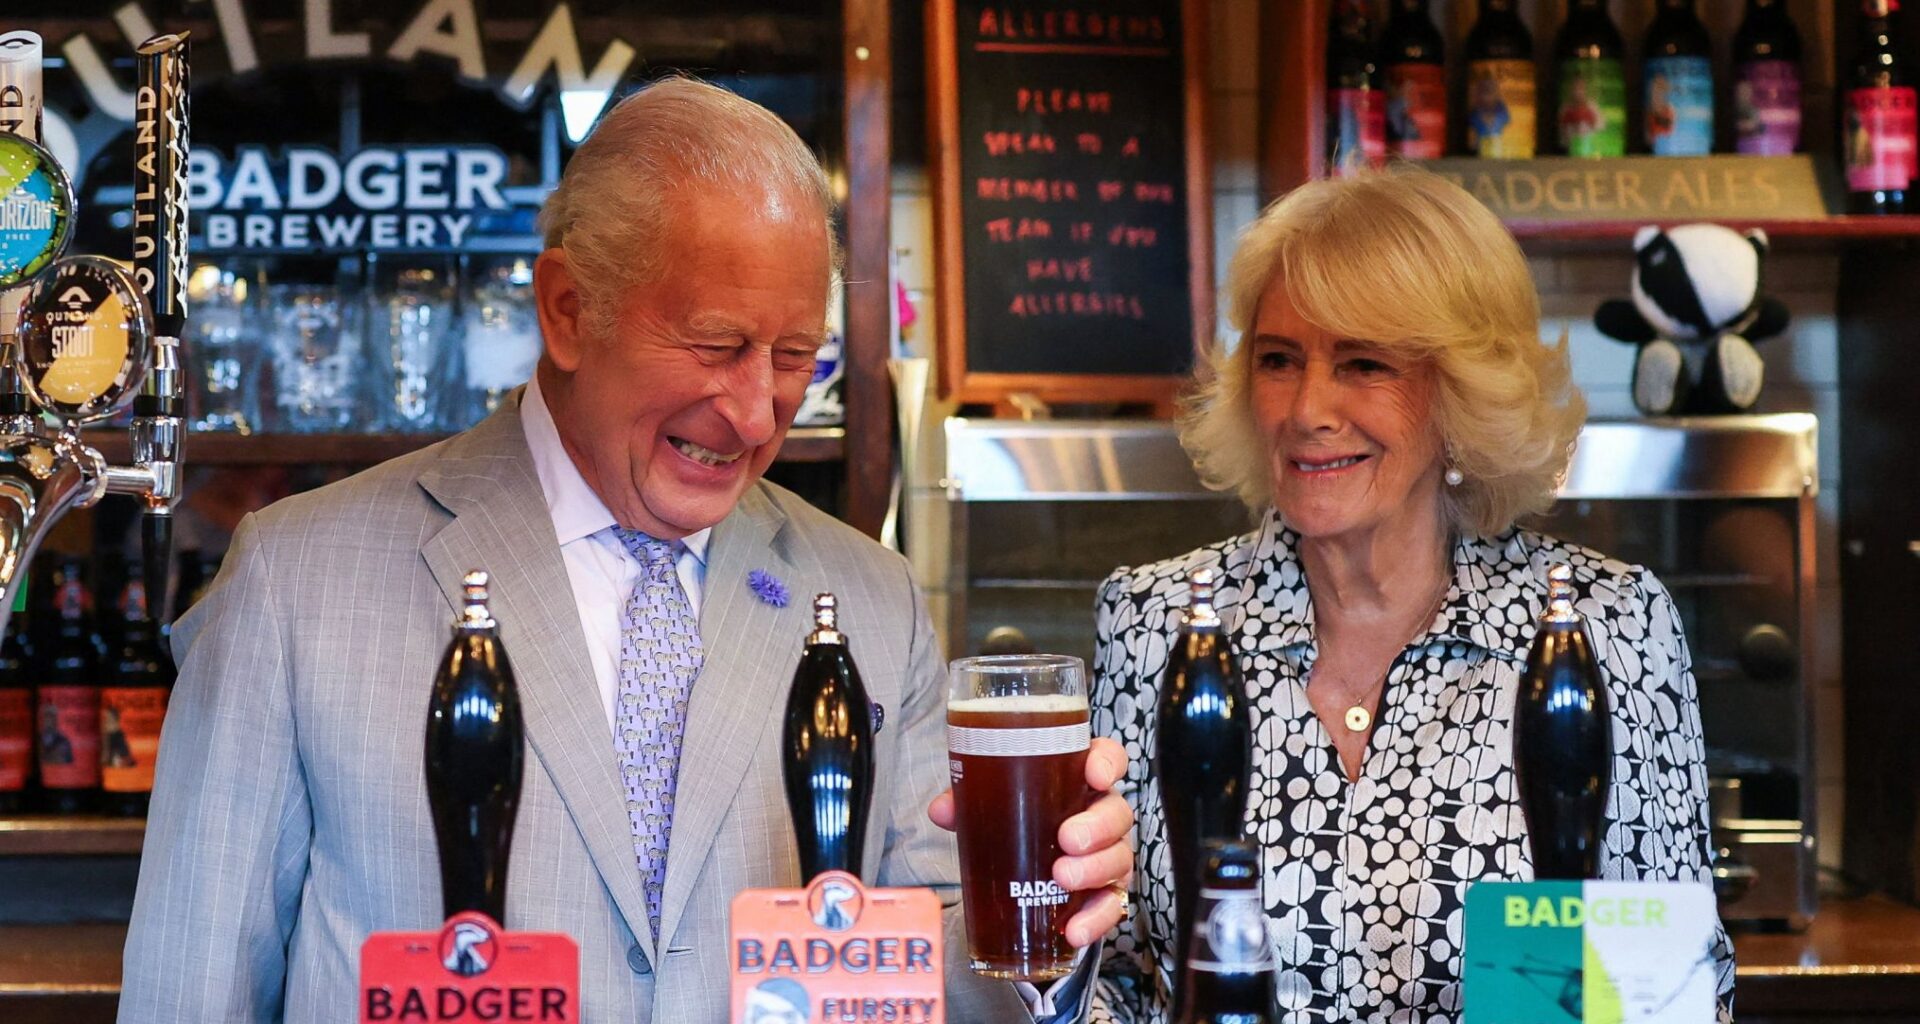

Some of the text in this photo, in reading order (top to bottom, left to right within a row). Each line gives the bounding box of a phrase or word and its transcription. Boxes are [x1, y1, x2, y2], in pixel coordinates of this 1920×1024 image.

[134, 86, 158, 294] OUTLAND
[189, 150, 504, 210] BADGER
[1456, 170, 1647, 212] ADGER
[207, 215, 470, 248] BREWERY
[51, 325, 96, 359] STOUT
[1017, 894, 1069, 907] BREWERY
[1504, 896, 1669, 928] BADGER
[738, 938, 935, 973] BADGER
[366, 986, 568, 1021] BADGER
[822, 997, 937, 1022] FURSTY
